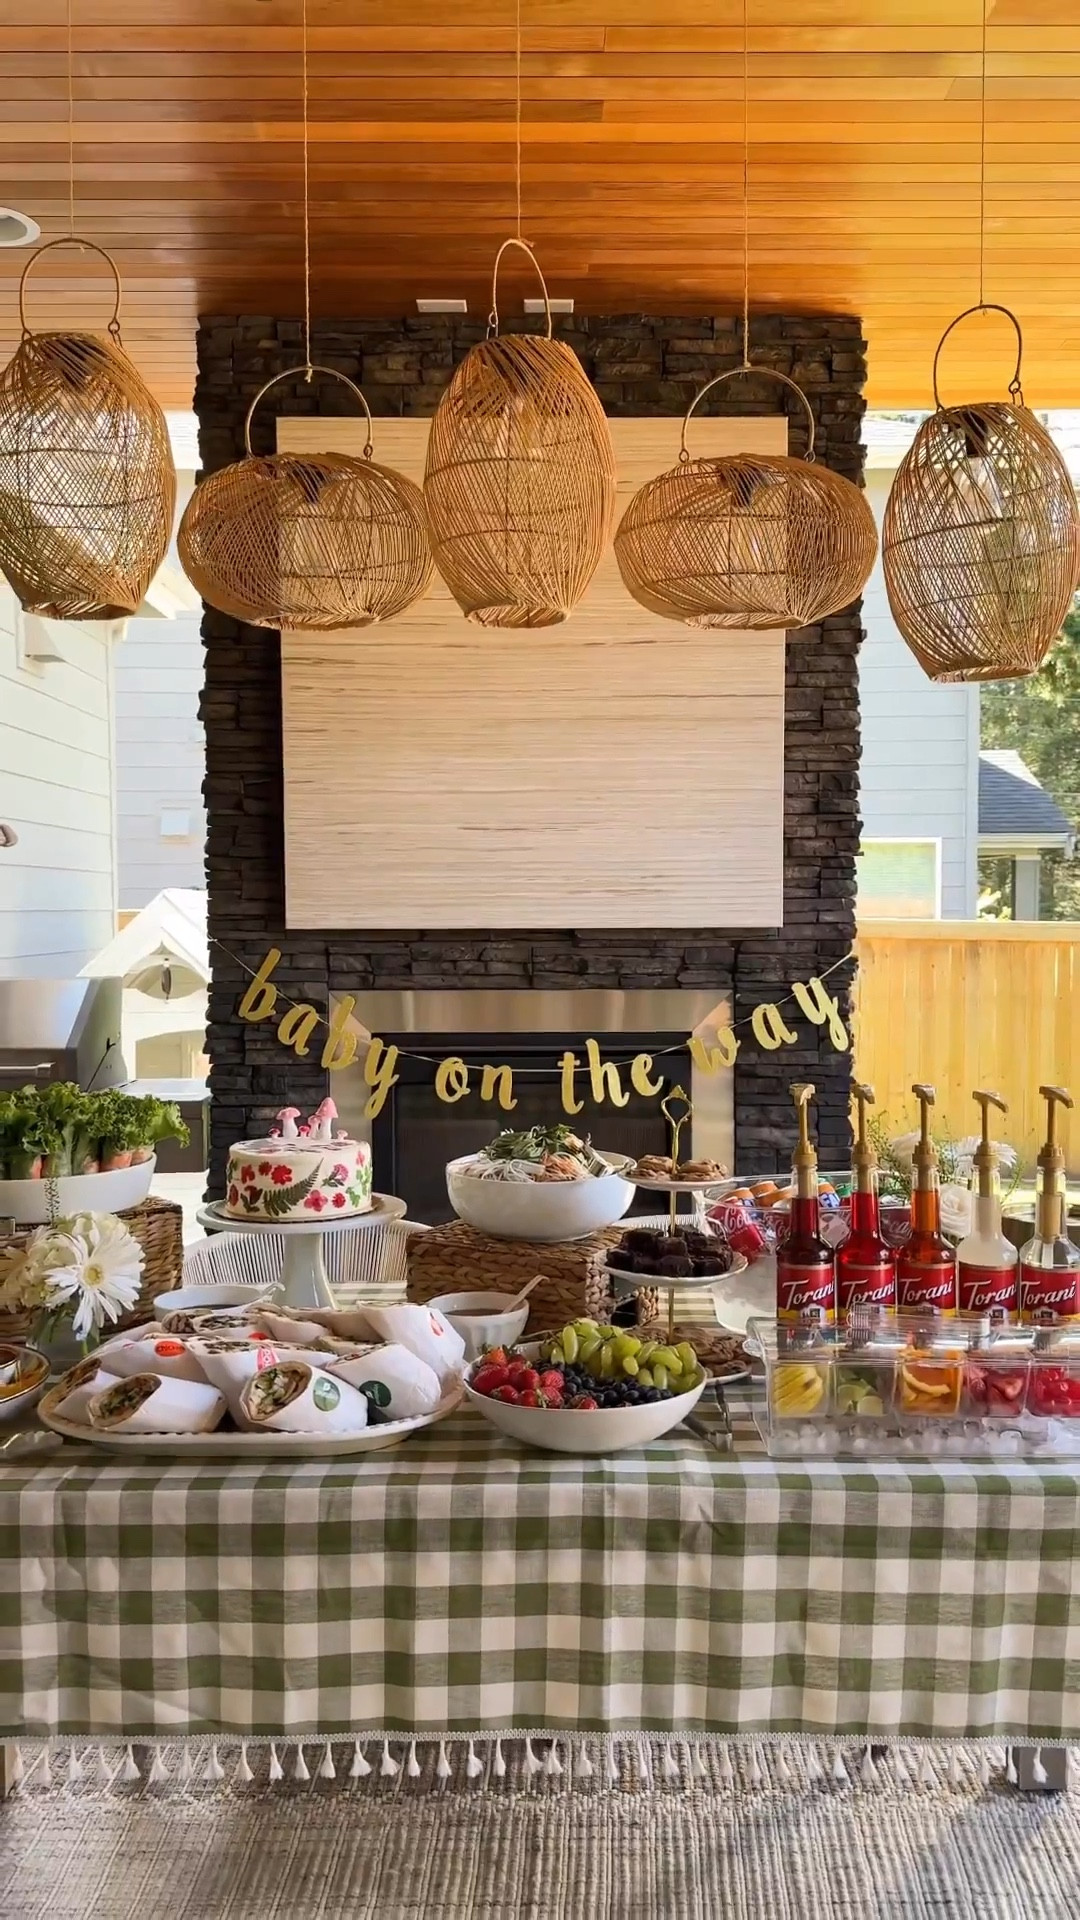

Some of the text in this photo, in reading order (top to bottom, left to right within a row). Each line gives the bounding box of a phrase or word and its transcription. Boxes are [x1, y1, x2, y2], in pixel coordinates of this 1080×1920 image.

[240, 949, 848, 1118] baby on the way
[782, 1277, 834, 1310] Torani
[842, 1276, 895, 1310] Torani
[901, 1276, 953, 1305] Torani
[1021, 1281, 1075, 1309] Torani
